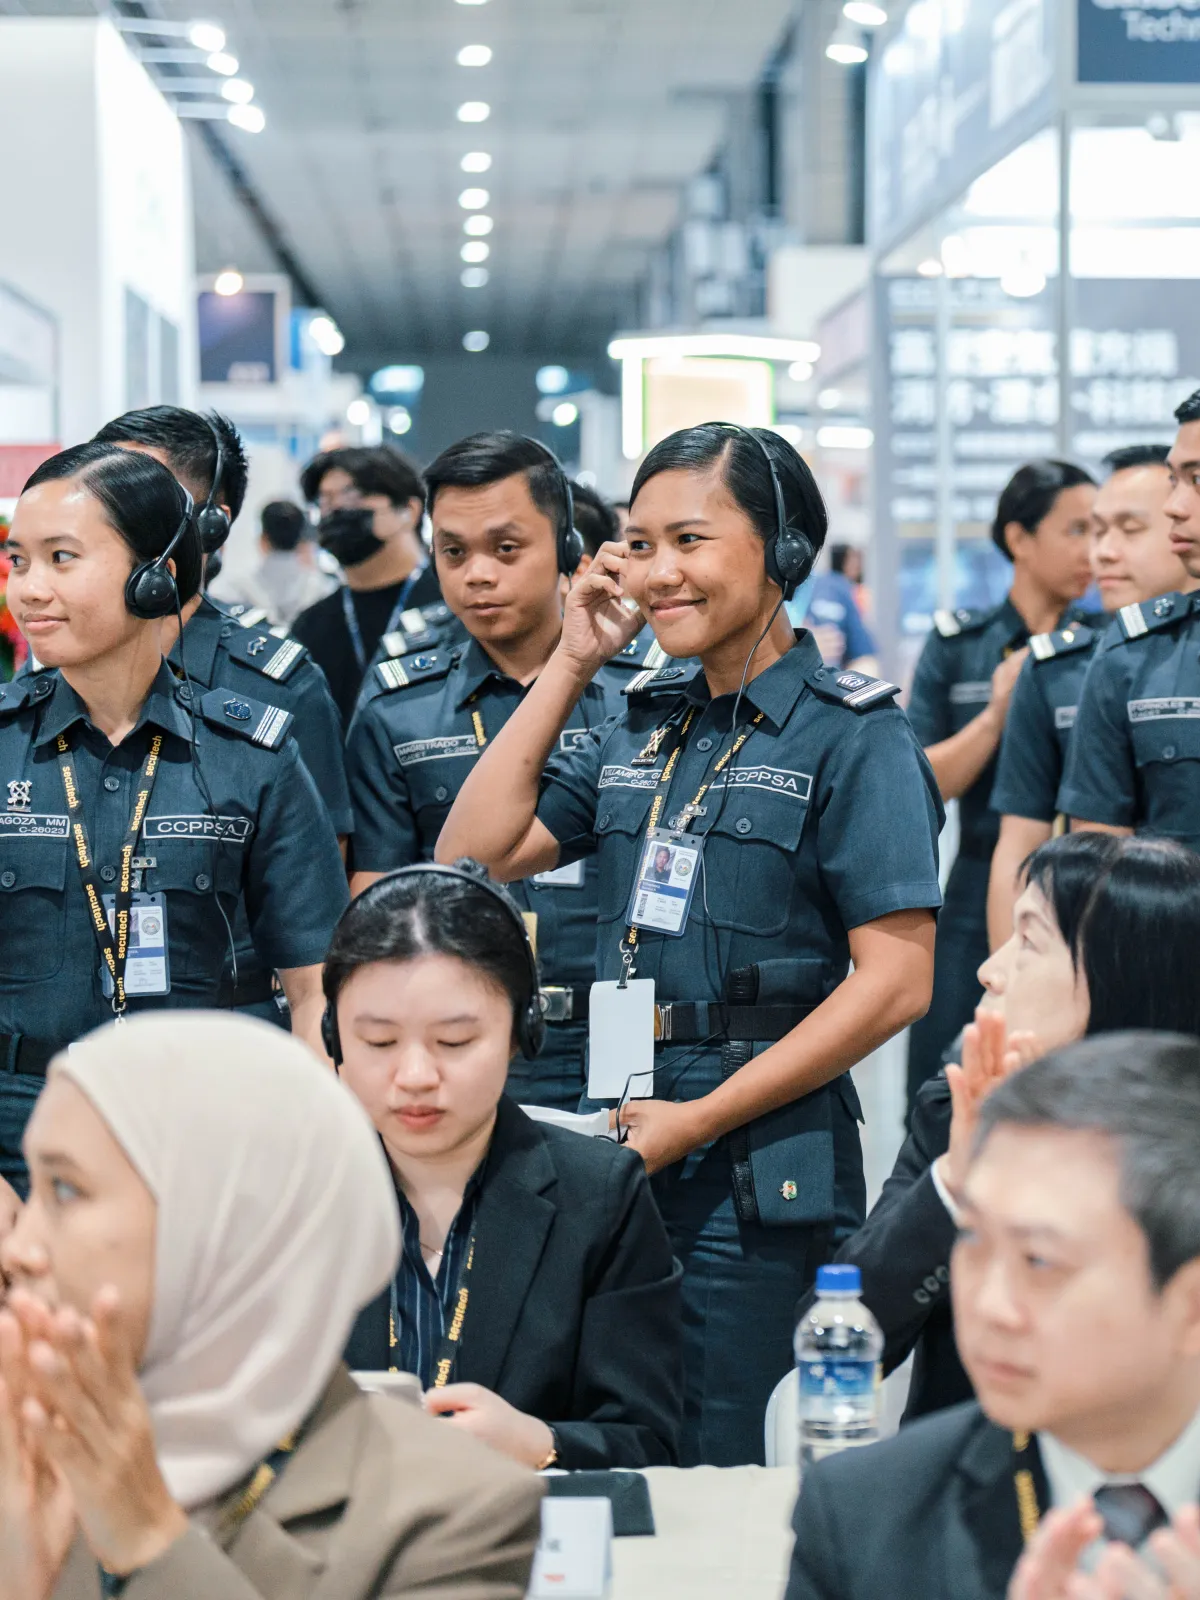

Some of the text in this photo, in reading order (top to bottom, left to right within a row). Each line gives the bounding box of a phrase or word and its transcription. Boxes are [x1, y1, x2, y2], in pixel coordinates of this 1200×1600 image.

[145, 735, 163, 777] secutech
[604, 769, 645, 779] VILLAMERO
[62, 766, 79, 808] secutech
[723, 771, 798, 791] CCPPSA
[46, 818, 66, 827] MM
[131, 790, 148, 832] secutech
[157, 821, 236, 835] CCPPSA
[647, 795, 663, 839] secutech
[73, 823, 91, 868] secutech
[120, 845, 132, 893] secutech
[86, 883, 107, 931] secutech
[118, 910, 128, 959] secutech
[103, 947, 117, 975] secu
[448, 1287, 469, 1342] secutech
